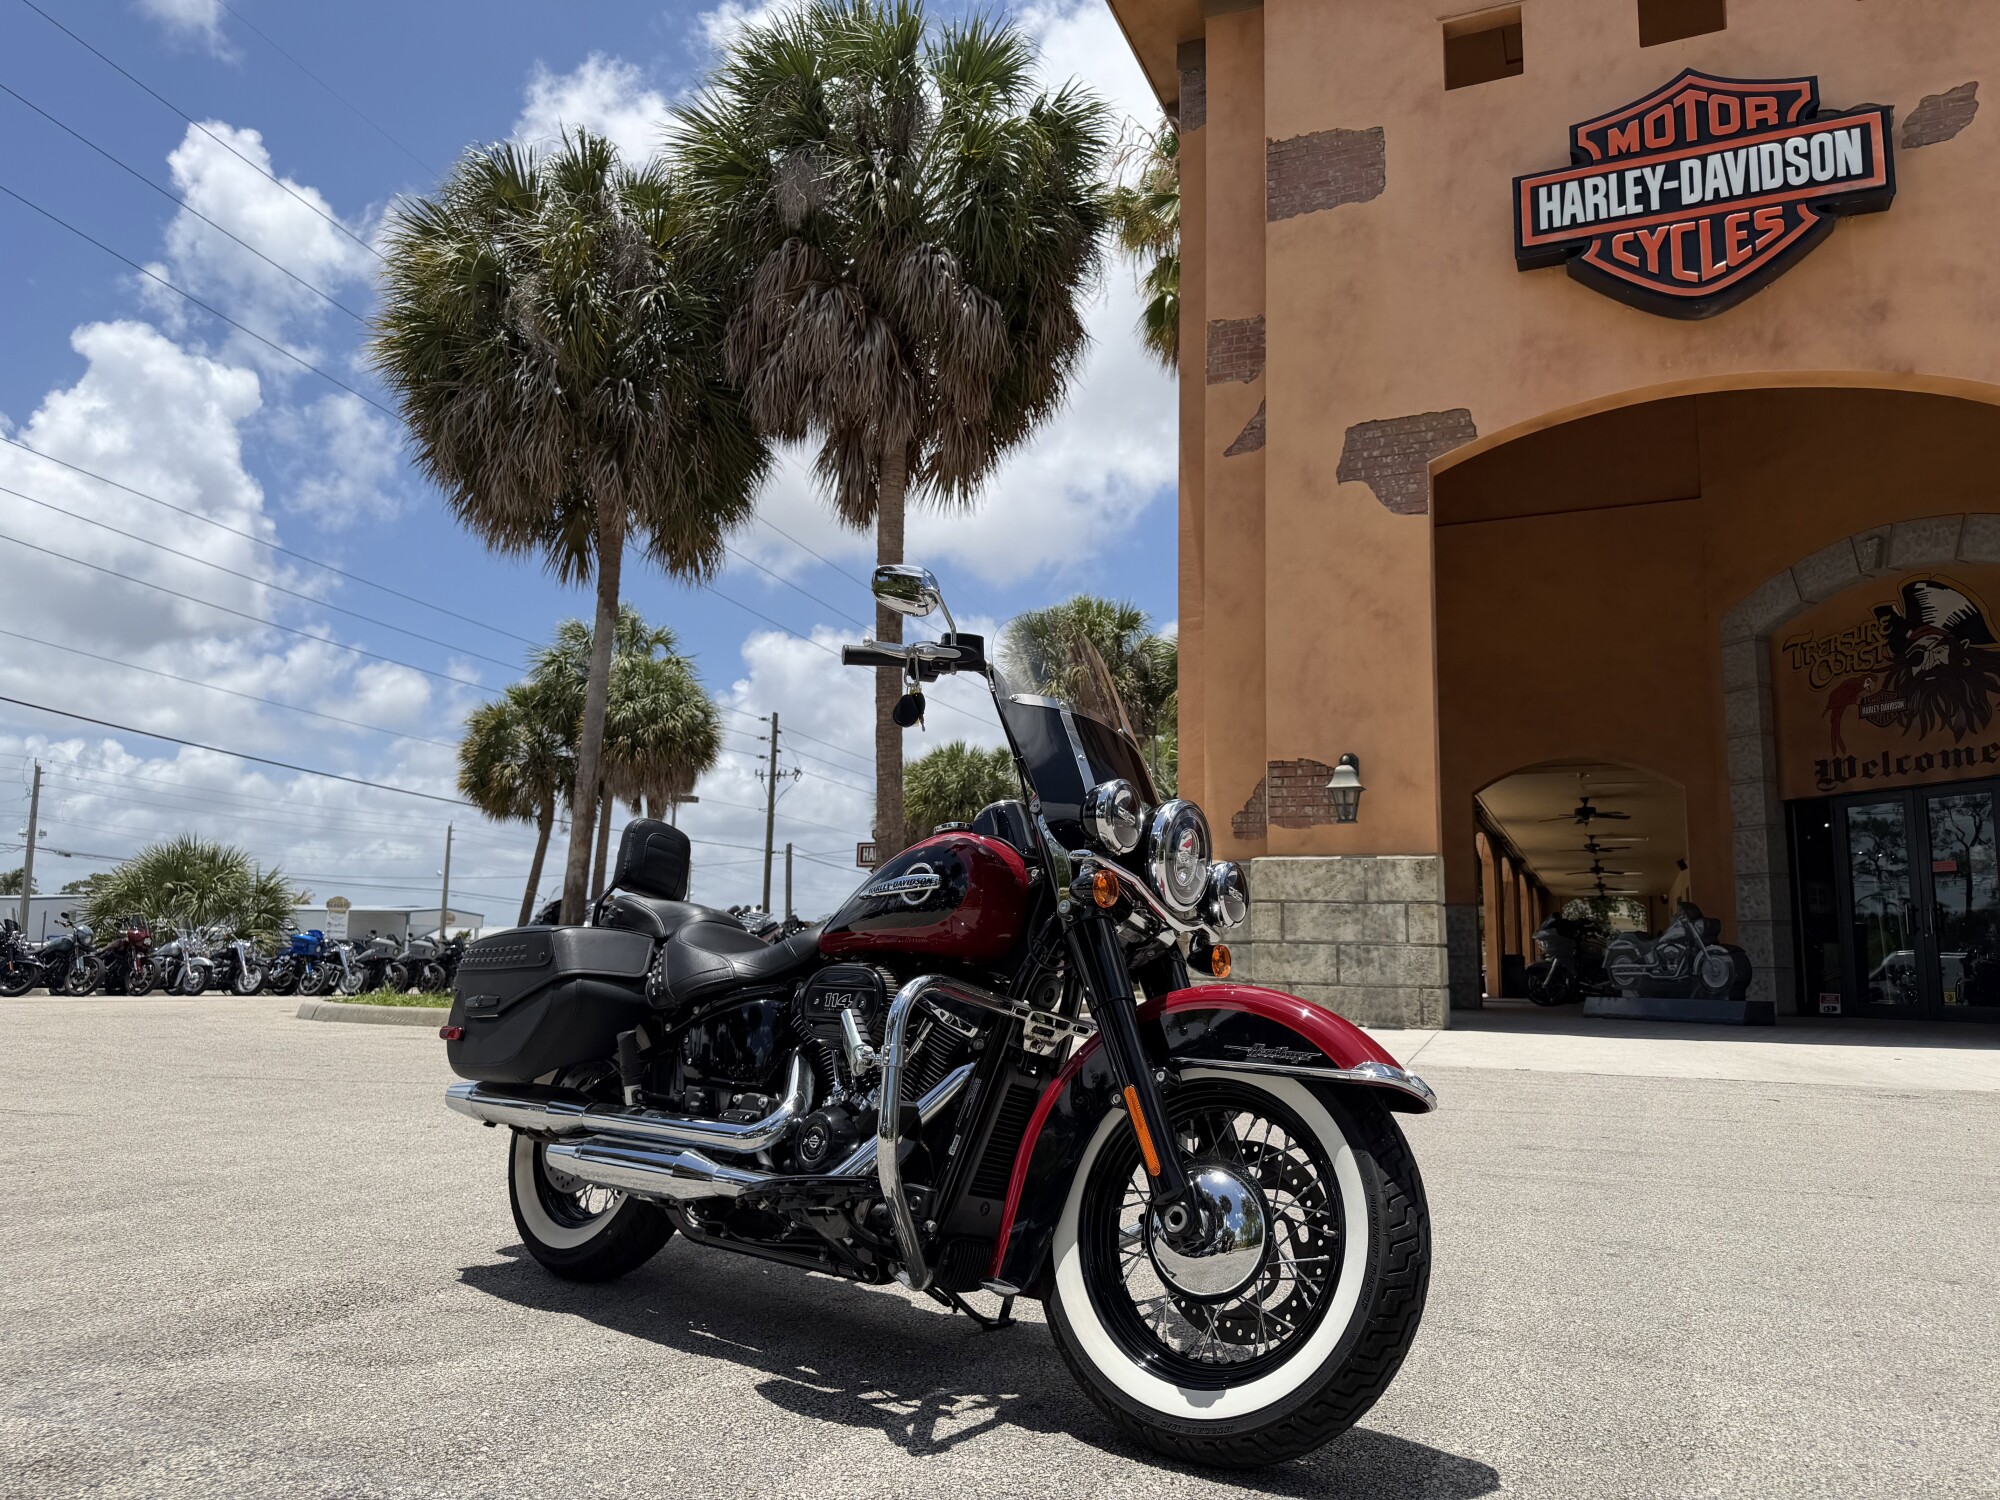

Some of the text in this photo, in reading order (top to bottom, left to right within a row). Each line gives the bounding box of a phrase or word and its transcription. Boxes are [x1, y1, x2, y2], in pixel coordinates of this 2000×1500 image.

[1607, 89, 1779, 157] MOTOR
[1538, 128, 1863, 230] HARLEY-DAVIDSON
[1612, 205, 1784, 282] CYCLES
[1782, 614, 1894, 670] TREASURE
[1809, 641, 1892, 689] COAST
[1814, 741, 2000, 791] Welcome
[868, 877, 932, 894] HARLEY-DAVIDSON
[824, 992, 853, 1008] 114
